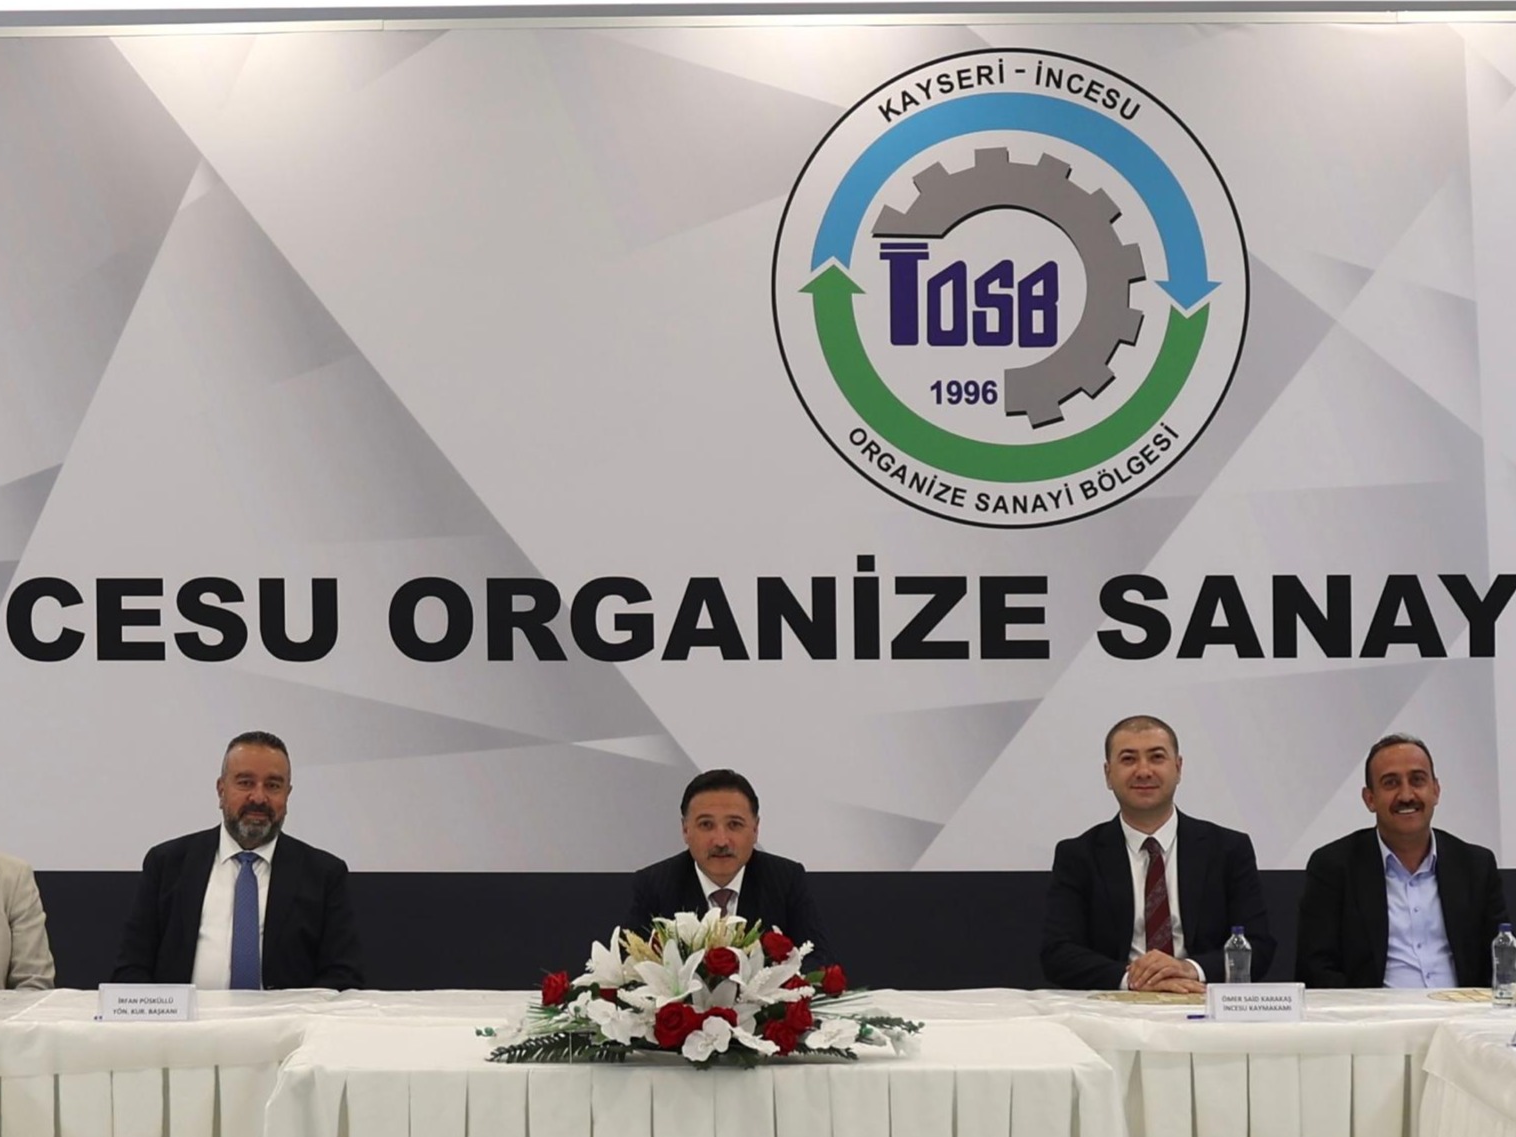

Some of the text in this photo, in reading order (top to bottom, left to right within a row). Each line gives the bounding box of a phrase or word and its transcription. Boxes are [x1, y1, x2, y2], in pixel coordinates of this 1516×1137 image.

[877, 58, 1005, 122] KAYSERİ
[1034, 60, 1142, 121] İNCESU
[930, 380, 998, 405] 1996
[848, 423, 1180, 514] ORGANİZE SANAYİ BÖLGESİ
[388, 555, 1050, 662] ORGANİZE
